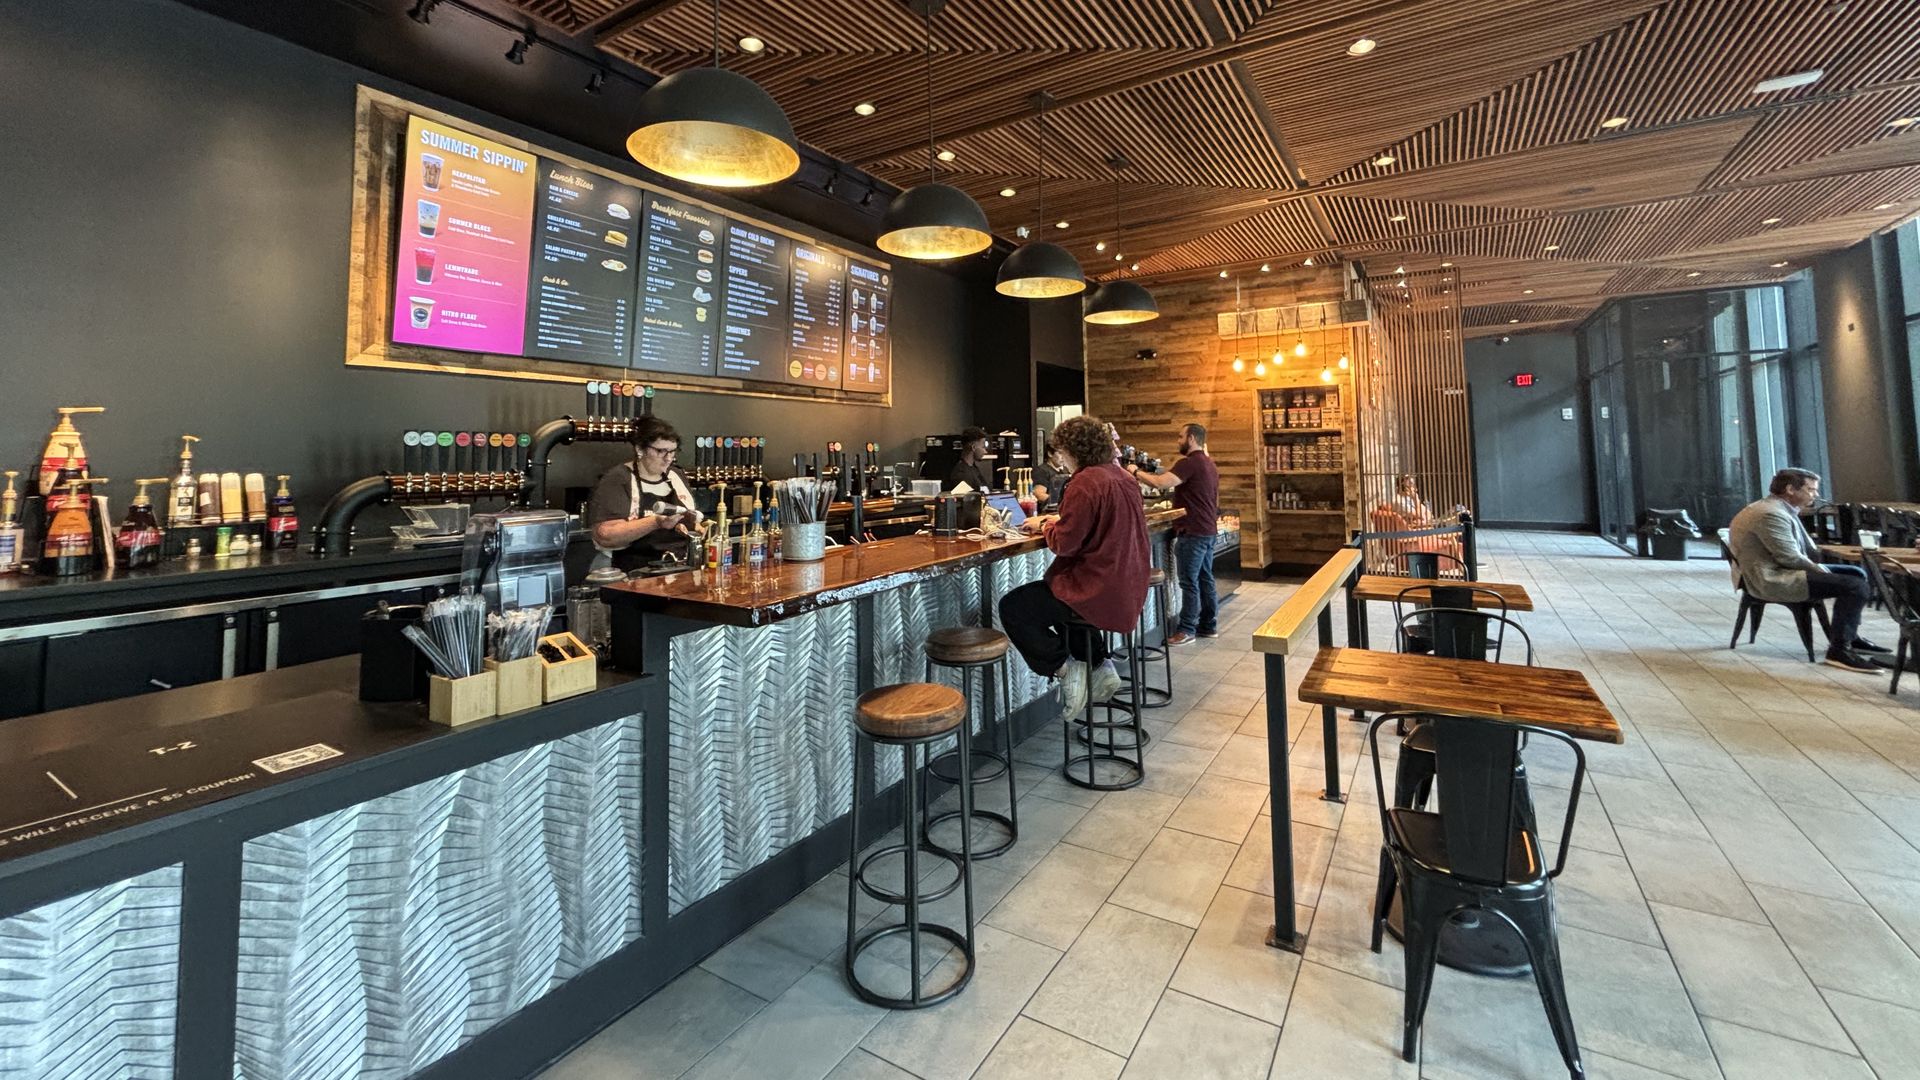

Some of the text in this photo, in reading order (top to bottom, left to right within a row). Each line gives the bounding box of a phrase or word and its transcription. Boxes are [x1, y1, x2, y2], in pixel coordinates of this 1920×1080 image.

[420, 129, 529, 174] SUMMER SIPPIN'
[549, 169, 594, 191] Lunch Bites
[651, 200, 683, 217] Breakfast
[682, 210, 710, 227] Favorites
[441, 309, 478, 321] NITRO FLOAT
[1516, 373, 1533, 387] EXIT
[148, 741, 198, 757] T-Z
[12, 825, 63, 841] WILL
[65, 803, 142, 828] RECEIVE
[146, 798, 157, 808] A
[160, 792, 183, 803] $5
[186, 772, 256, 795] COUPON!
